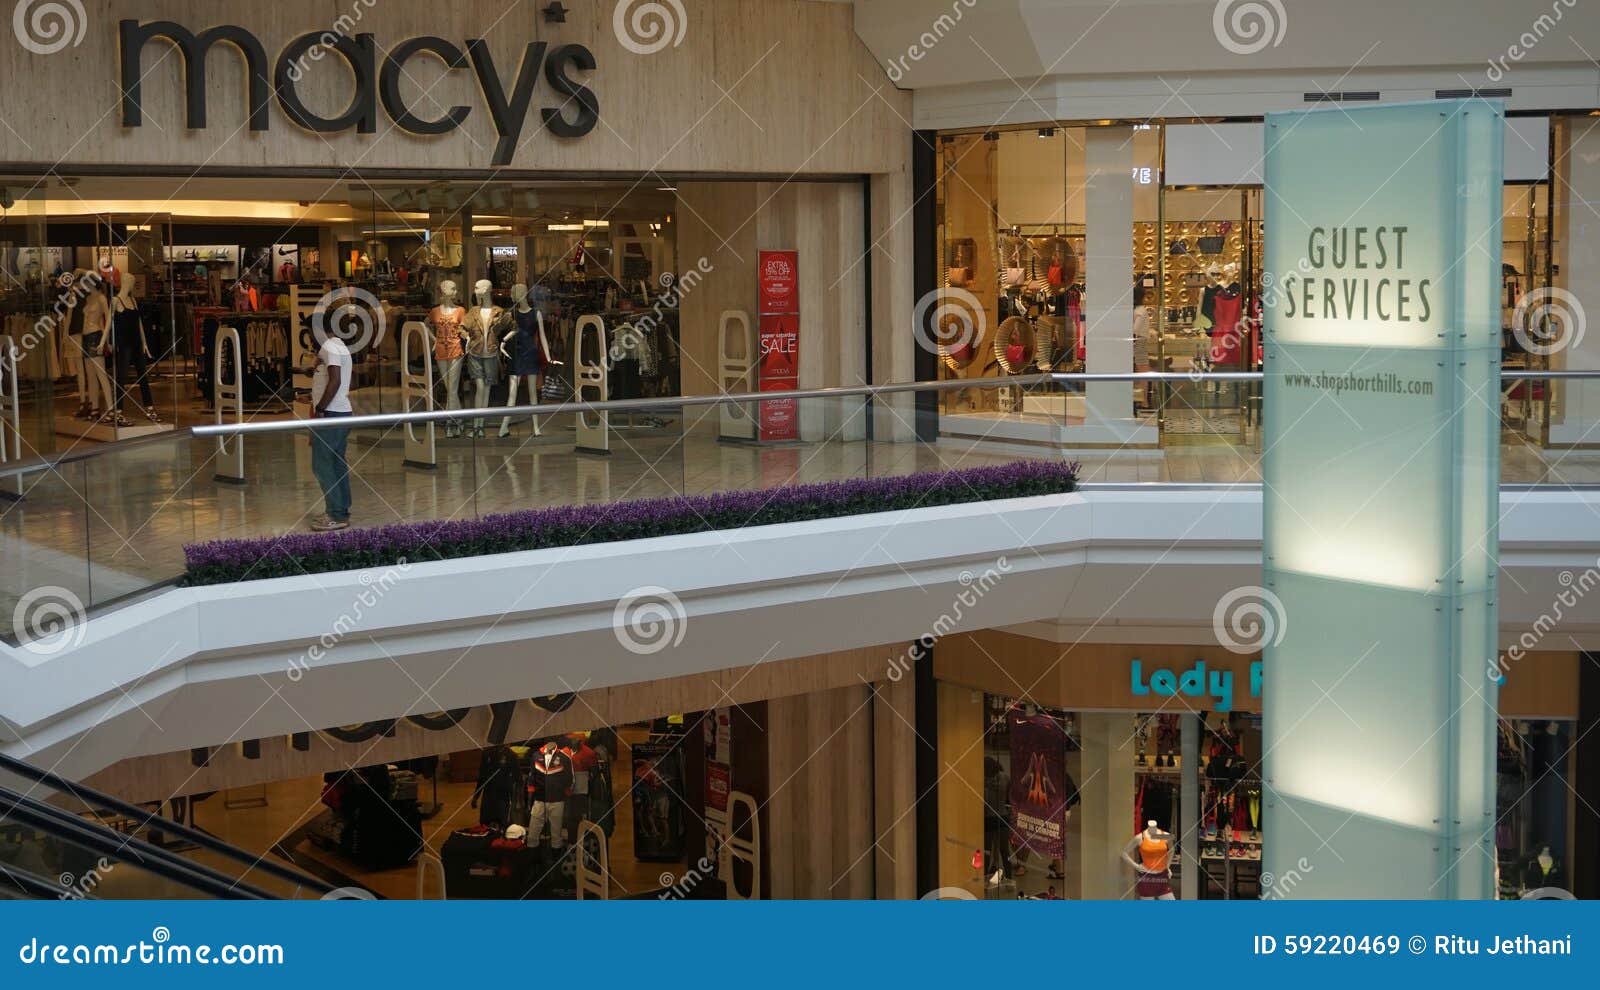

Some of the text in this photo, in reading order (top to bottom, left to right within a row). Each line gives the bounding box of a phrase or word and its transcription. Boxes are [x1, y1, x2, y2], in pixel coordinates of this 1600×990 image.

[1308, 226, 1407, 269] GUEST
[767, 261, 788, 269] EXTRA
[1285, 277, 1431, 323] SERVICES
[761, 338, 797, 354] SALE
[1285, 371, 1433, 397] www.shopshorthills.com
[1131, 659, 1233, 712] Lady
